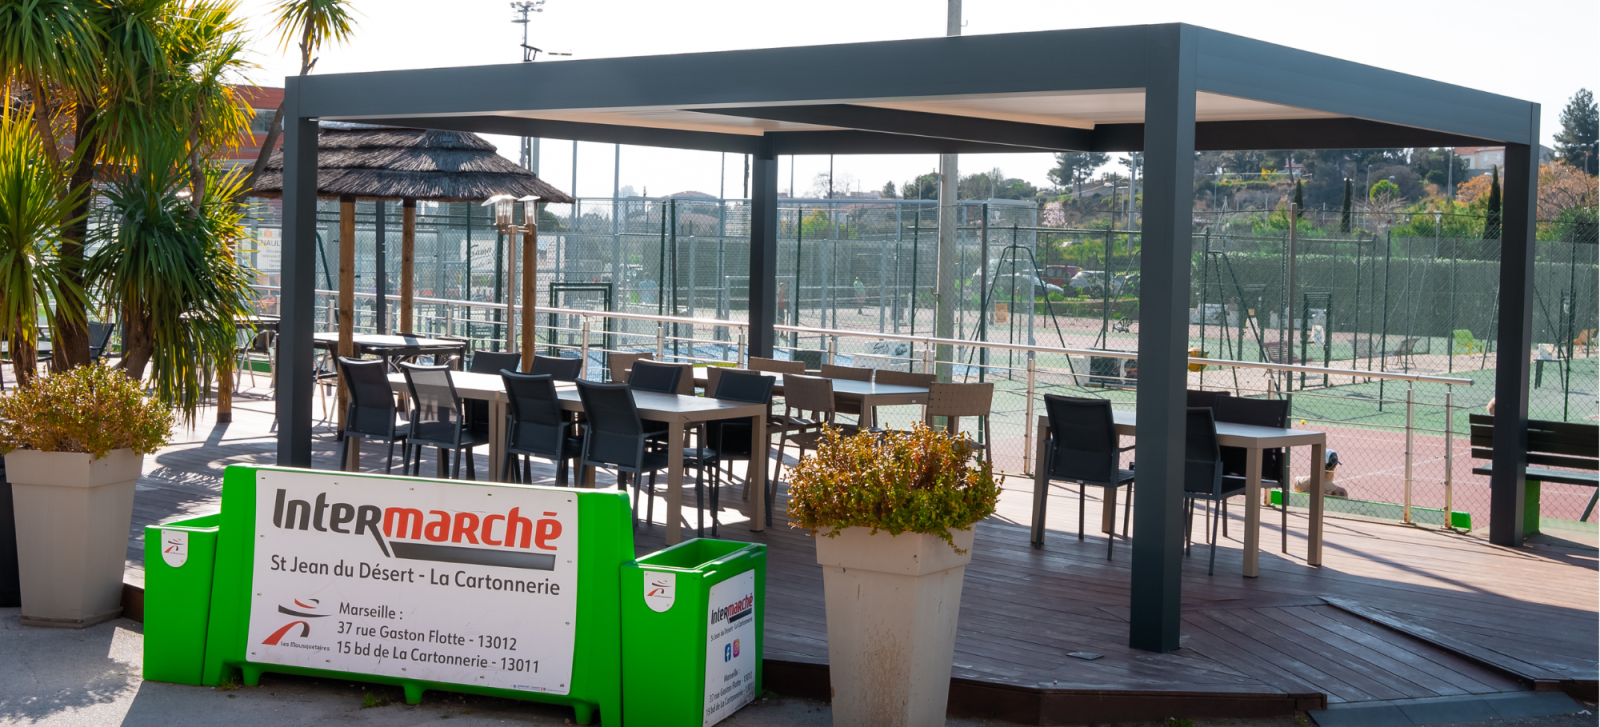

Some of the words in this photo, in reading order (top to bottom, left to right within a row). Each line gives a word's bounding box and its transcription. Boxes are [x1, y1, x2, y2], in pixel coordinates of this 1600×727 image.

[273, 488, 562, 558] Intermarché
[270, 554, 287, 572] St
[290, 556, 329, 575] Jean
[333, 559, 354, 578] du
[359, 562, 414, 583] Désert
[430, 568, 449, 586] La
[454, 570, 560, 596] Cartonnerie
[339, 602, 396, 619] Marseille
[710, 592, 754, 625] Intermarché
[337, 621, 353, 634] 37
[356, 626, 376, 637] rue
[379, 625, 425, 642] Gaston
[428, 630, 465, 646] Flotte
[478, 635, 517, 651] 13012
[337, 641, 351, 654] 15
[354, 641, 370, 656] bd
[373, 644, 389, 658] de
[392, 646, 407, 660] La
[410, 648, 488, 668] Cartonnerie
[501, 657, 539, 674] 13011
[720, 685, 732, 697] Gaston
[732, 679, 742, 689] Flotte
[723, 668, 738, 683] Marseille
[715, 702, 721, 711] de
[724, 688, 744, 706] Cartonnerie
